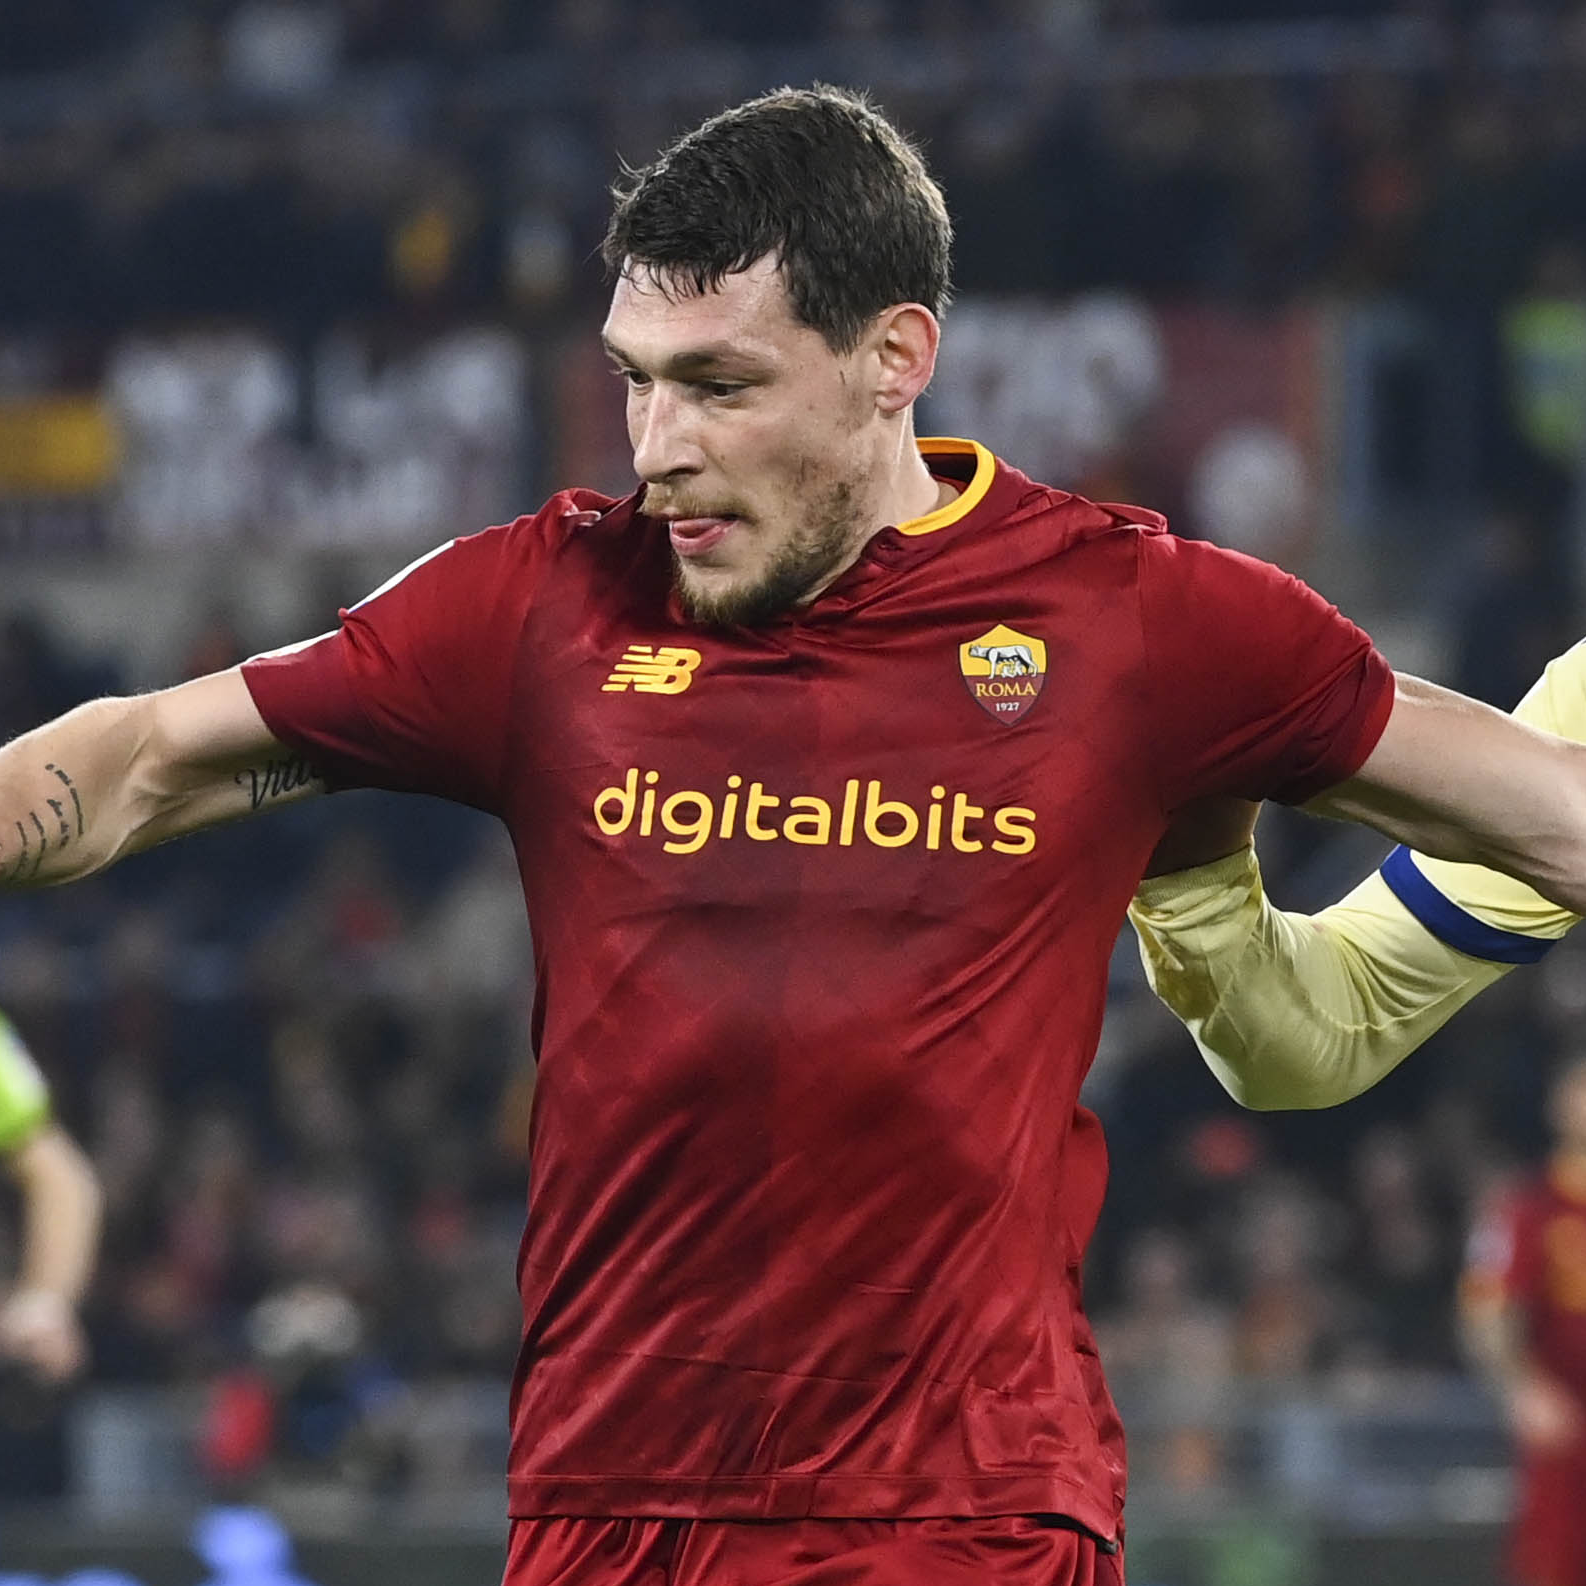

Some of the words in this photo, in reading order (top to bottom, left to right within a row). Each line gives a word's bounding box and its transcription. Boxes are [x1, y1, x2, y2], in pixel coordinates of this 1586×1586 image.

[975, 682, 1038, 697] ROMA
[995, 702, 1020, 711] 1927
[593, 767, 1037, 855] digitalbits
